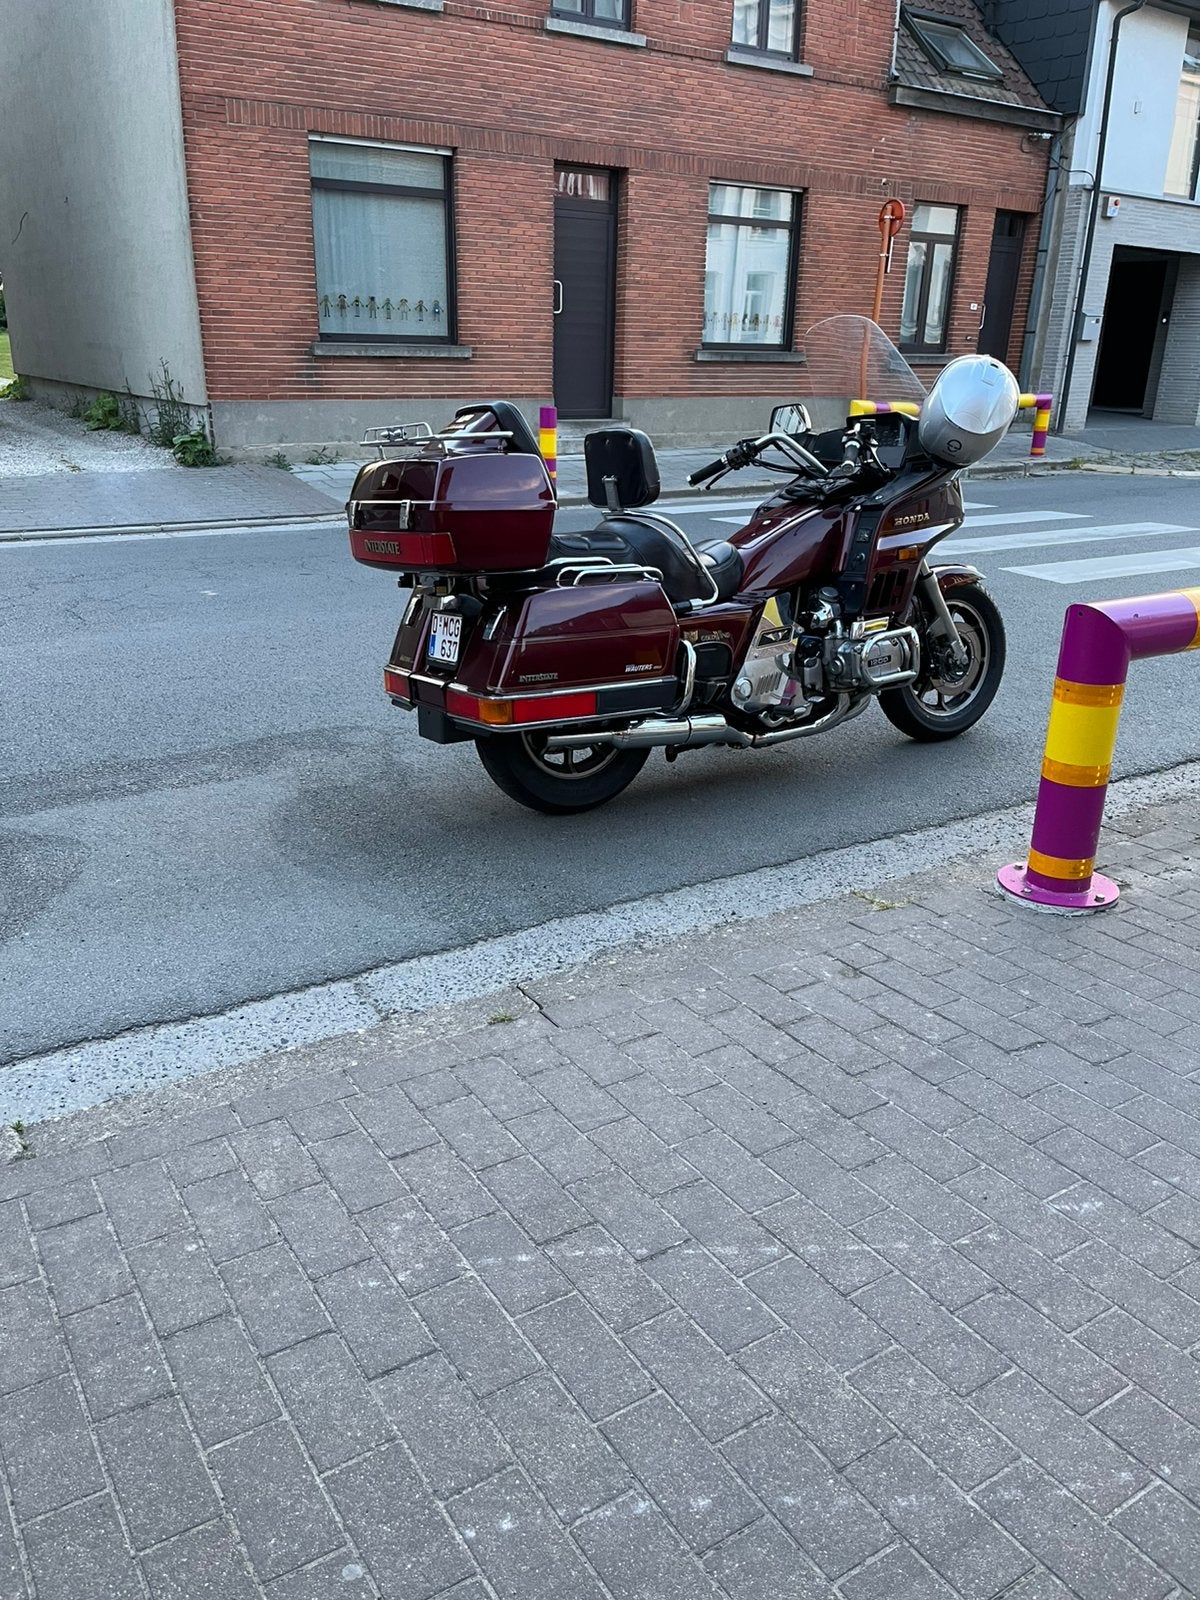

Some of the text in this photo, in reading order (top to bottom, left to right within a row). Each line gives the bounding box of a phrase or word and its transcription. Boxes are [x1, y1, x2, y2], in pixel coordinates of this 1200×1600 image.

[894, 512, 930, 526] HONDA
[364, 539, 400, 555] INTERSTATE
[440, 639, 458, 660] 637
[870, 656, 889, 666] 1200
[519, 672, 559, 683] INTERSTATE
